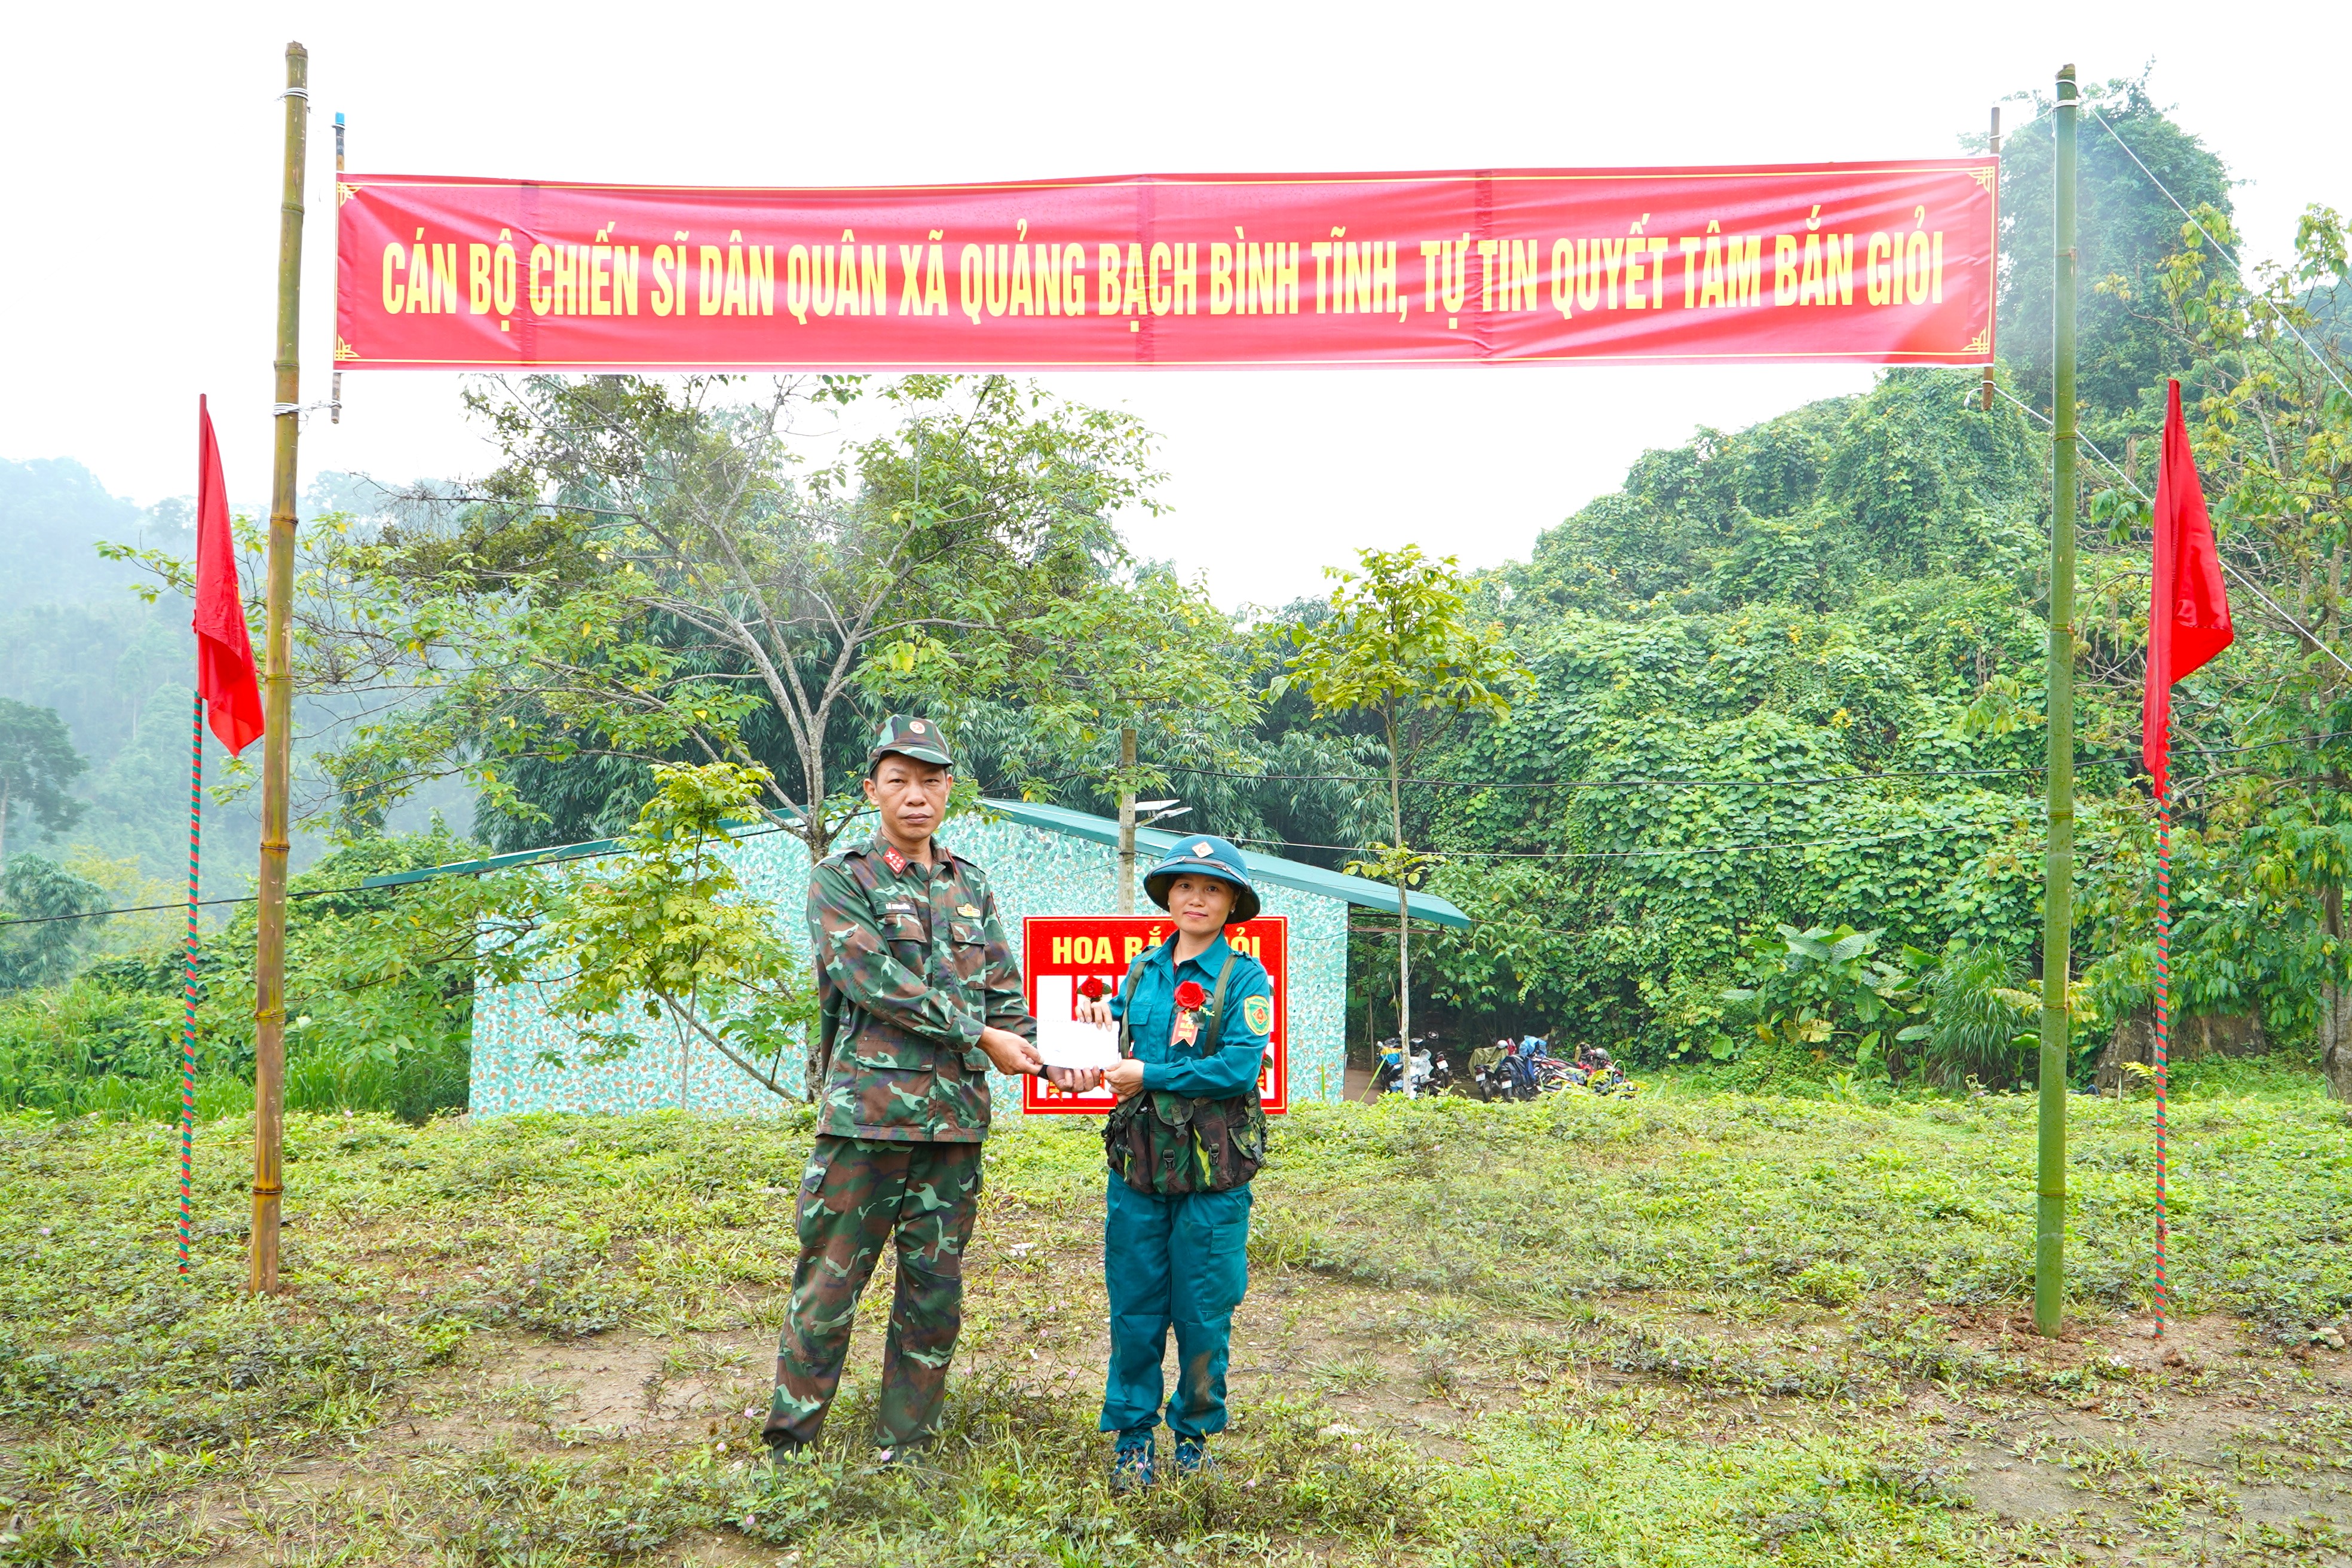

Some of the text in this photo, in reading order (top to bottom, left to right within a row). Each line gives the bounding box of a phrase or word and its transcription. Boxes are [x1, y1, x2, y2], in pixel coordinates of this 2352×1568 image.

[382, 204, 1944, 333] CÁN BỘ CHIẾN SĨ DÂN QUÂN XÃ QUẢNG BẠCH BÌNH TĨNH, TỰ TIN QUYẾT TÂM BẮN GIỎI
[1053, 936, 1114, 964] HOA
[1125, 926, 1162, 964] BẮ
